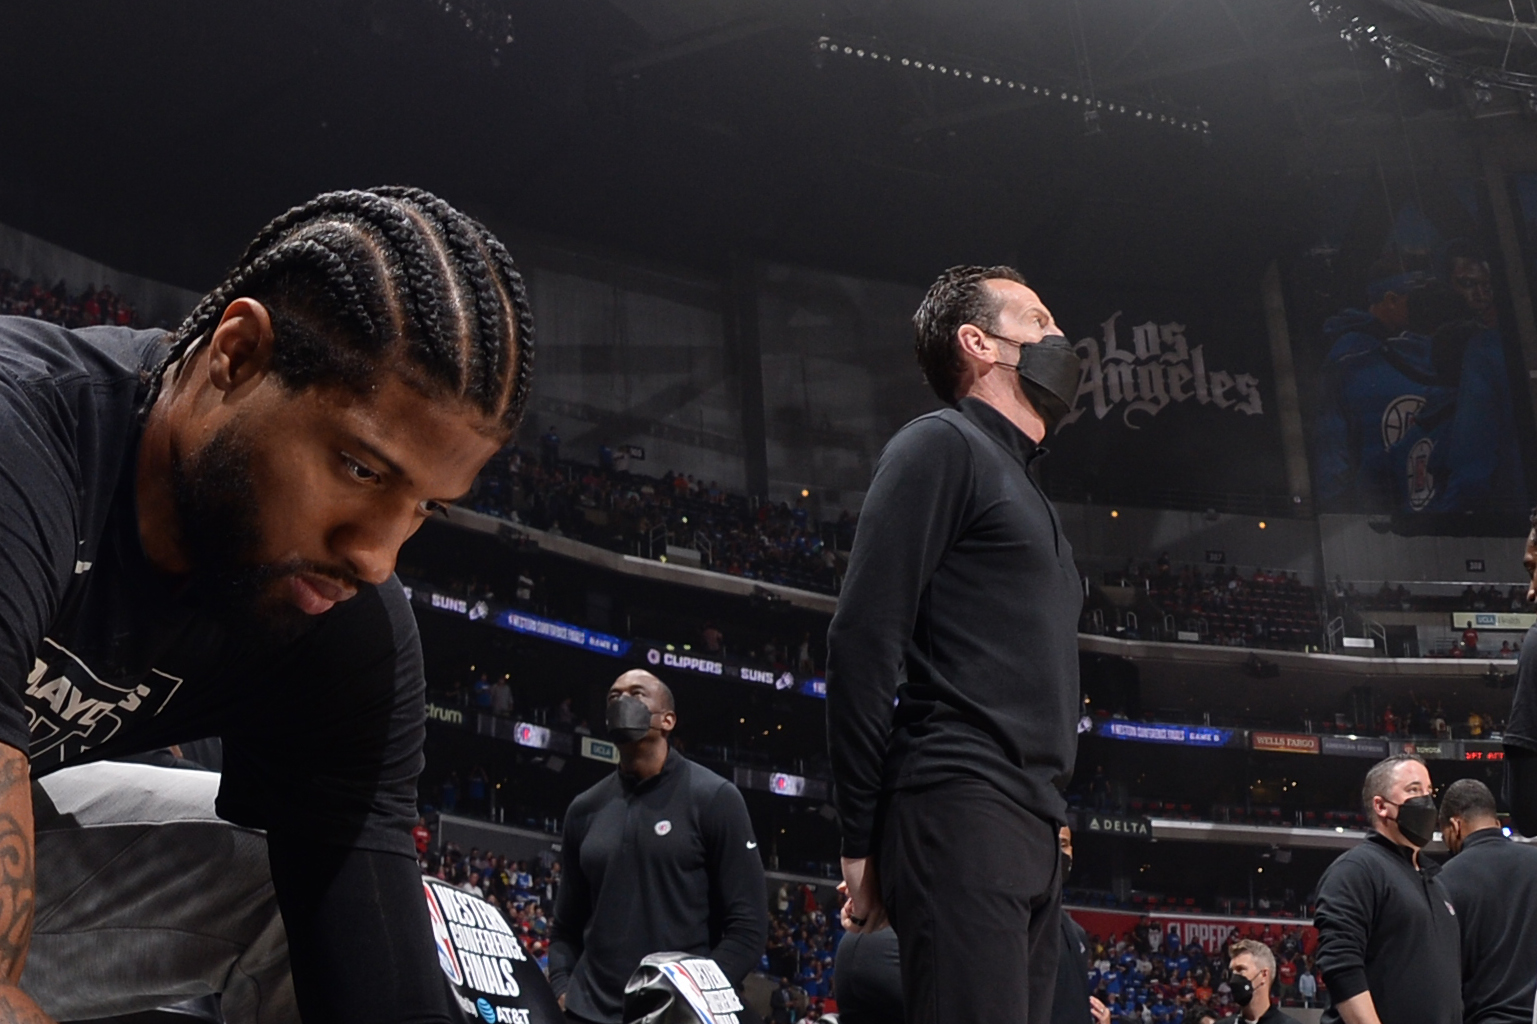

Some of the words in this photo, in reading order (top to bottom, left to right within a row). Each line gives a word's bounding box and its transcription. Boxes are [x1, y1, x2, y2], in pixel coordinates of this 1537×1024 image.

[1100, 310, 1191, 364] Los
[1053, 336, 1263, 435] Angeles
[431, 592, 467, 615] SUNS
[663, 652, 723, 676] CLIPPERS
[740, 667, 774, 685] SUNS
[425, 702, 463, 724] ctrum
[1256, 736, 1286, 747] WELLS
[1286, 737, 1315, 749] FARGO
[1416, 746, 1442, 754] TOYOTA
[1103, 818, 1148, 835] DELTA
[431, 883, 514, 937] WESTERN
[448, 921, 528, 962] CONFERENCE
[457, 949, 520, 998] FINALS
